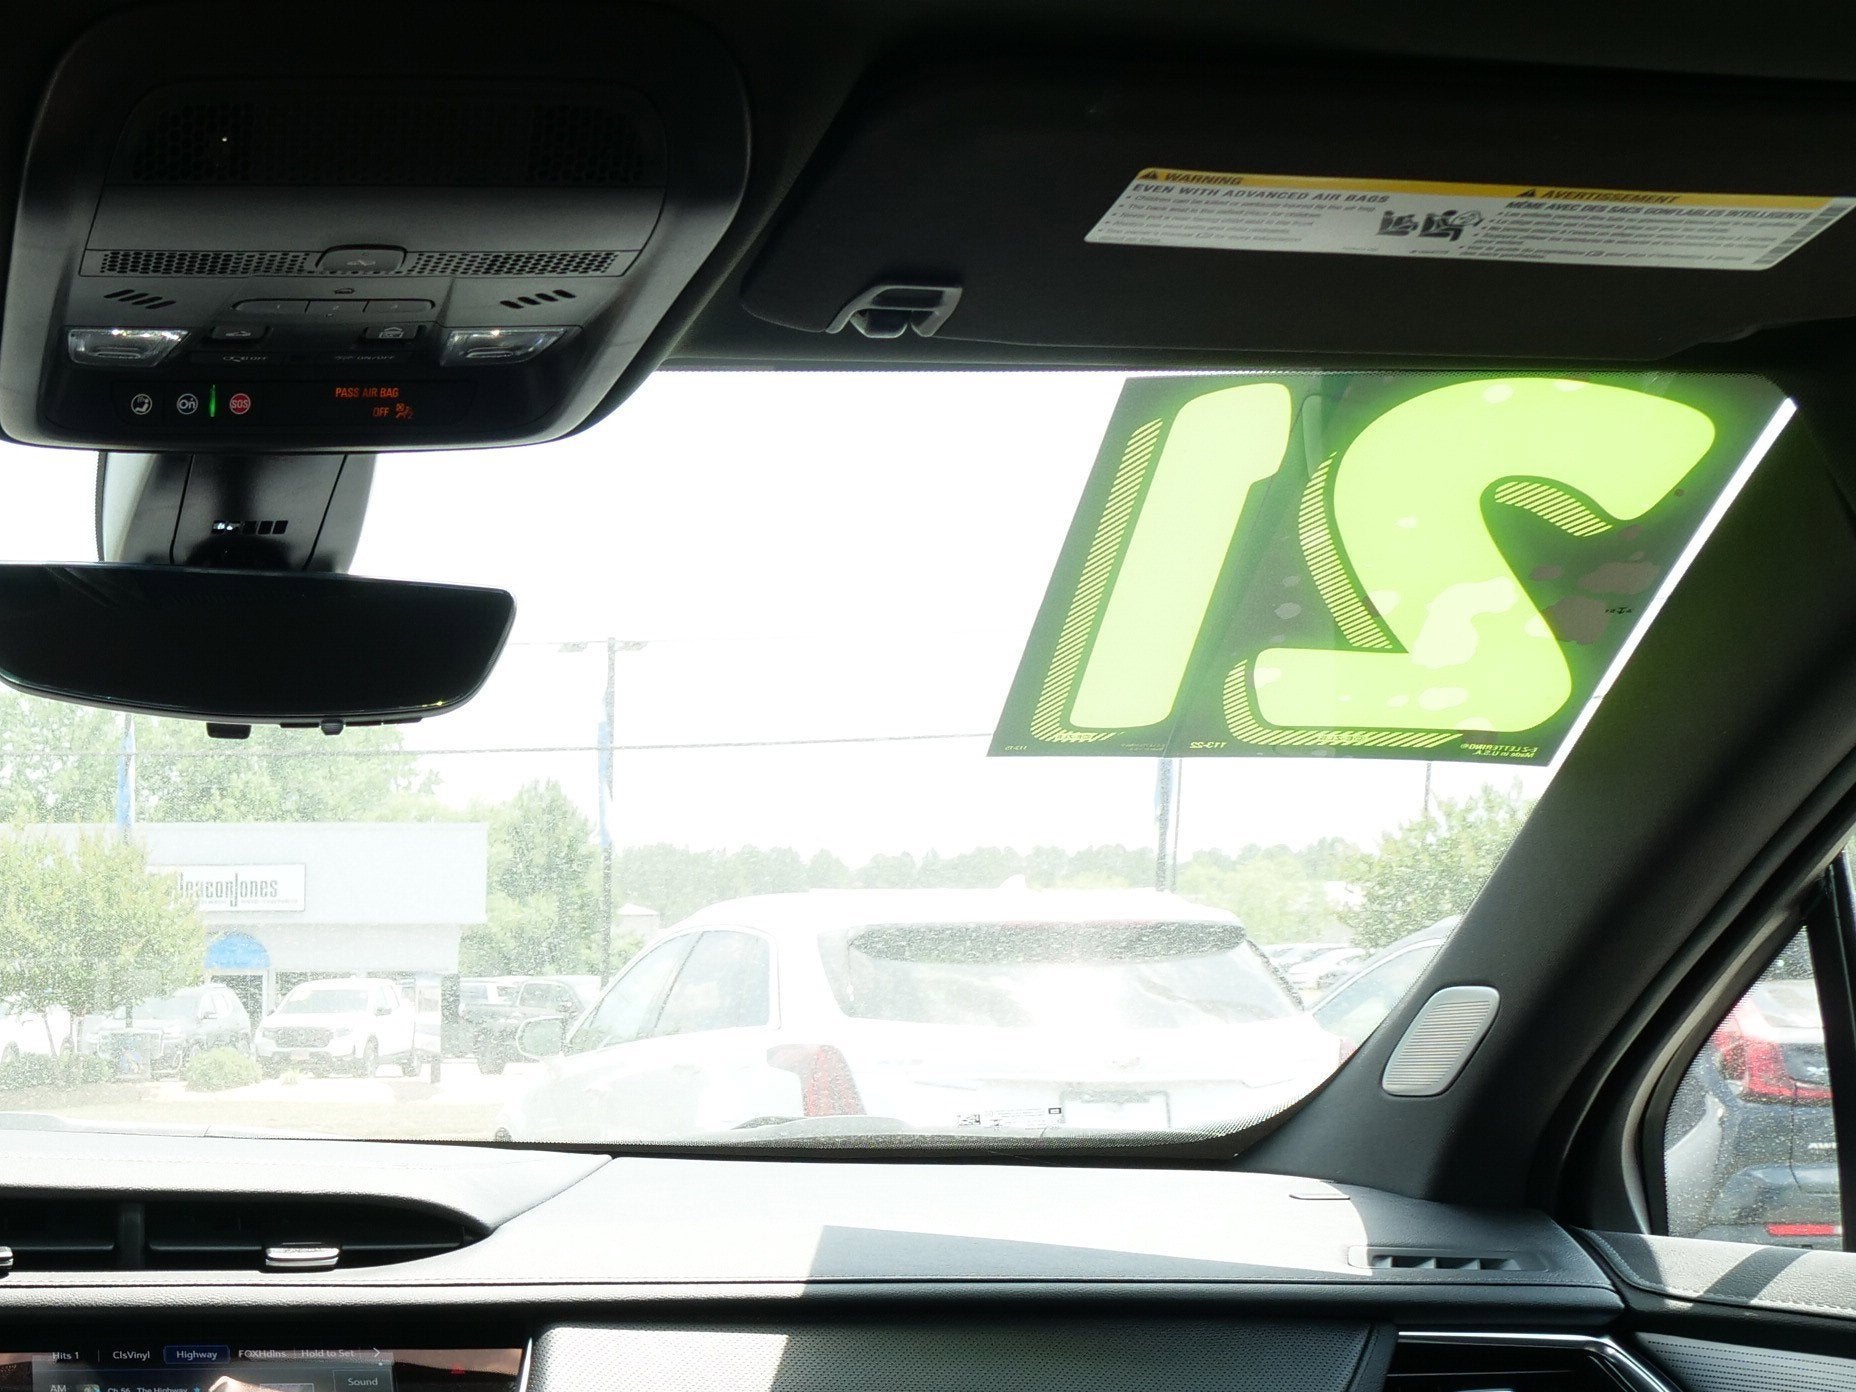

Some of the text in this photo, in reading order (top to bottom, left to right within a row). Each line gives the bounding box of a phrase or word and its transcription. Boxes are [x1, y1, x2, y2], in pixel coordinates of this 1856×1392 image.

[1165, 172, 1243, 186] WARNING
[1133, 184, 1174, 194] EVEN
[1179, 186, 1220, 197] WITH
[1222, 189, 1309, 200] ADVANCED
[1312, 192, 1341, 201] AIR
[1344, 194, 1391, 203] BAGS
[335, 387, 400, 398] PASS AIR BAG
[372, 407, 390, 418] OFF
[52, 1351, 72, 1360] Hits
[112, 1350, 151, 1360] ClsVinyl
[176, 1350, 218, 1361] Highway
[301, 1349, 323, 1358] Hold
[339, 1349, 355, 1358] Set
[347, 1377, 378, 1386] Sound
[49, 1384, 67, 1392] AM
